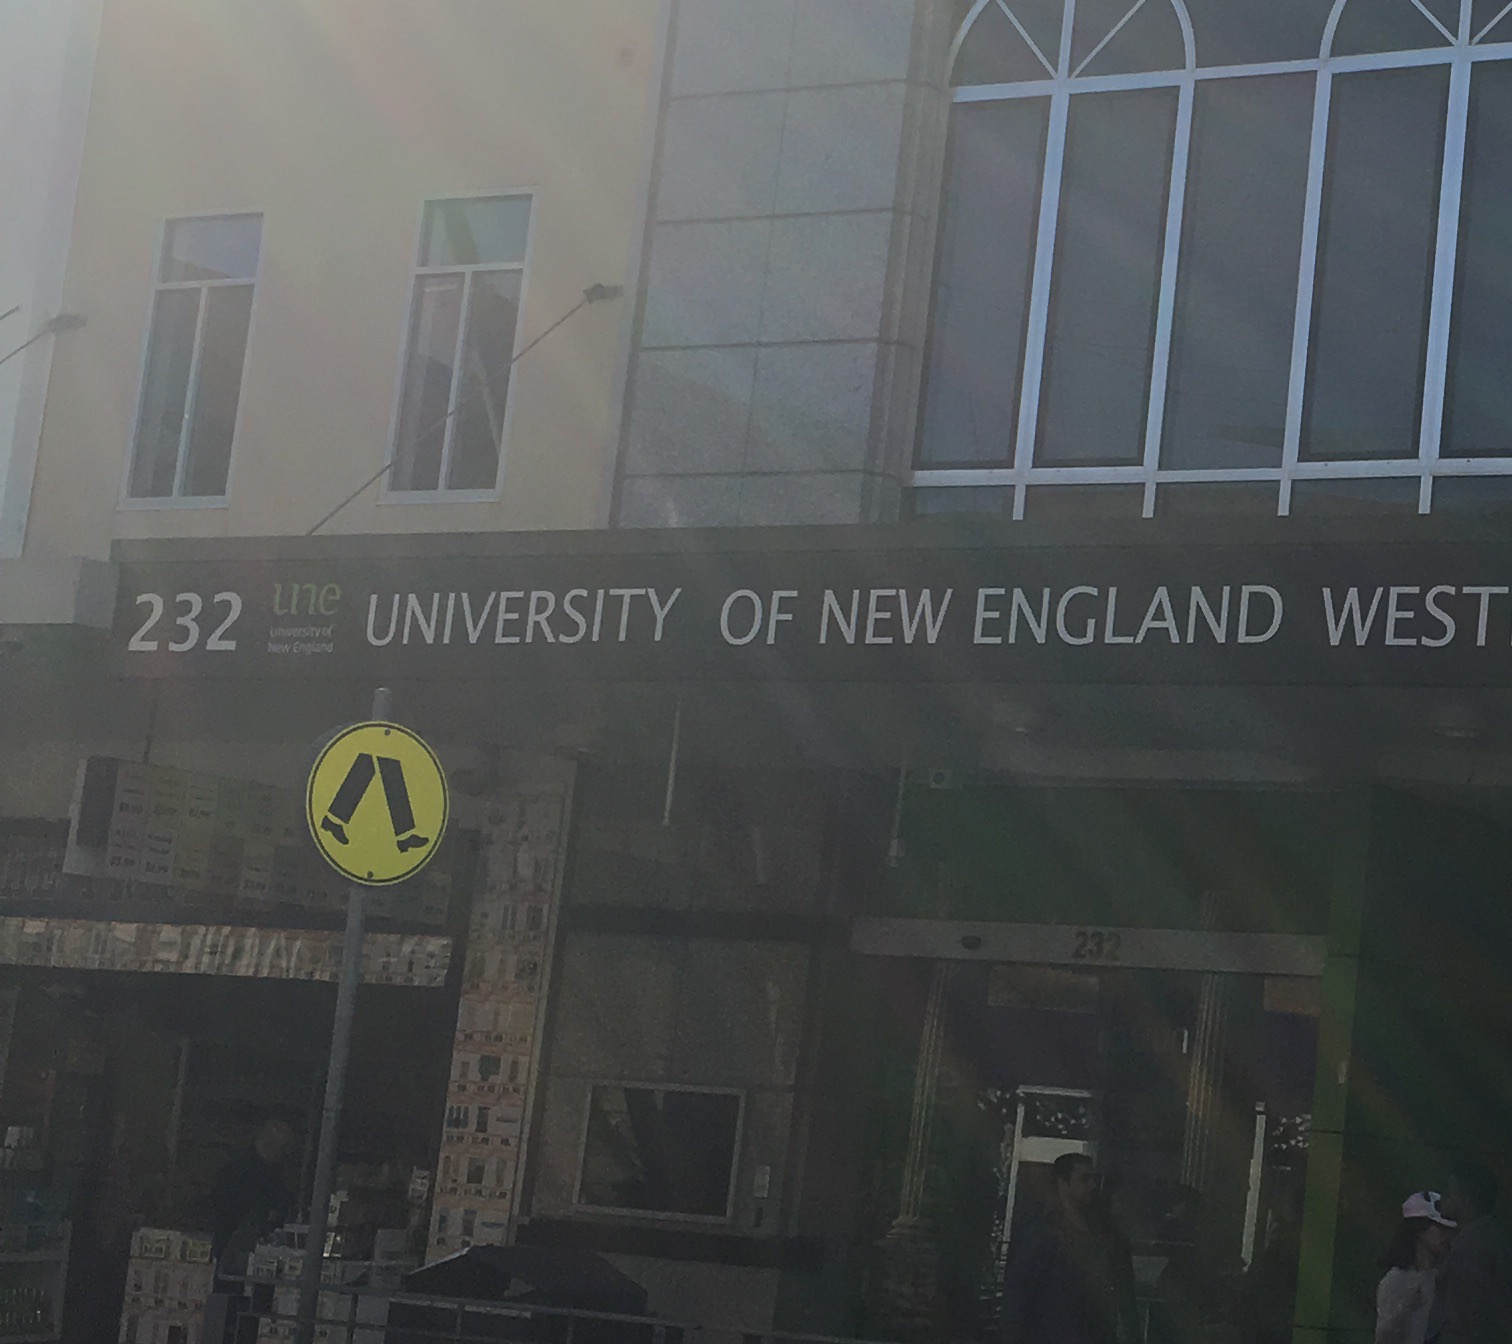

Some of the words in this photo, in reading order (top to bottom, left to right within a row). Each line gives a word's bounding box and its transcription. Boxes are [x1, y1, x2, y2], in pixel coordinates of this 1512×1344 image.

[127, 592, 242, 653] 232
[366, 588, 681, 647] UNIVERSITY
[719, 588, 799, 647] OF
[818, 587, 954, 646] NEW
[972, 583, 1285, 647] ENGLAND
[1071, 929, 1121, 961] 232
